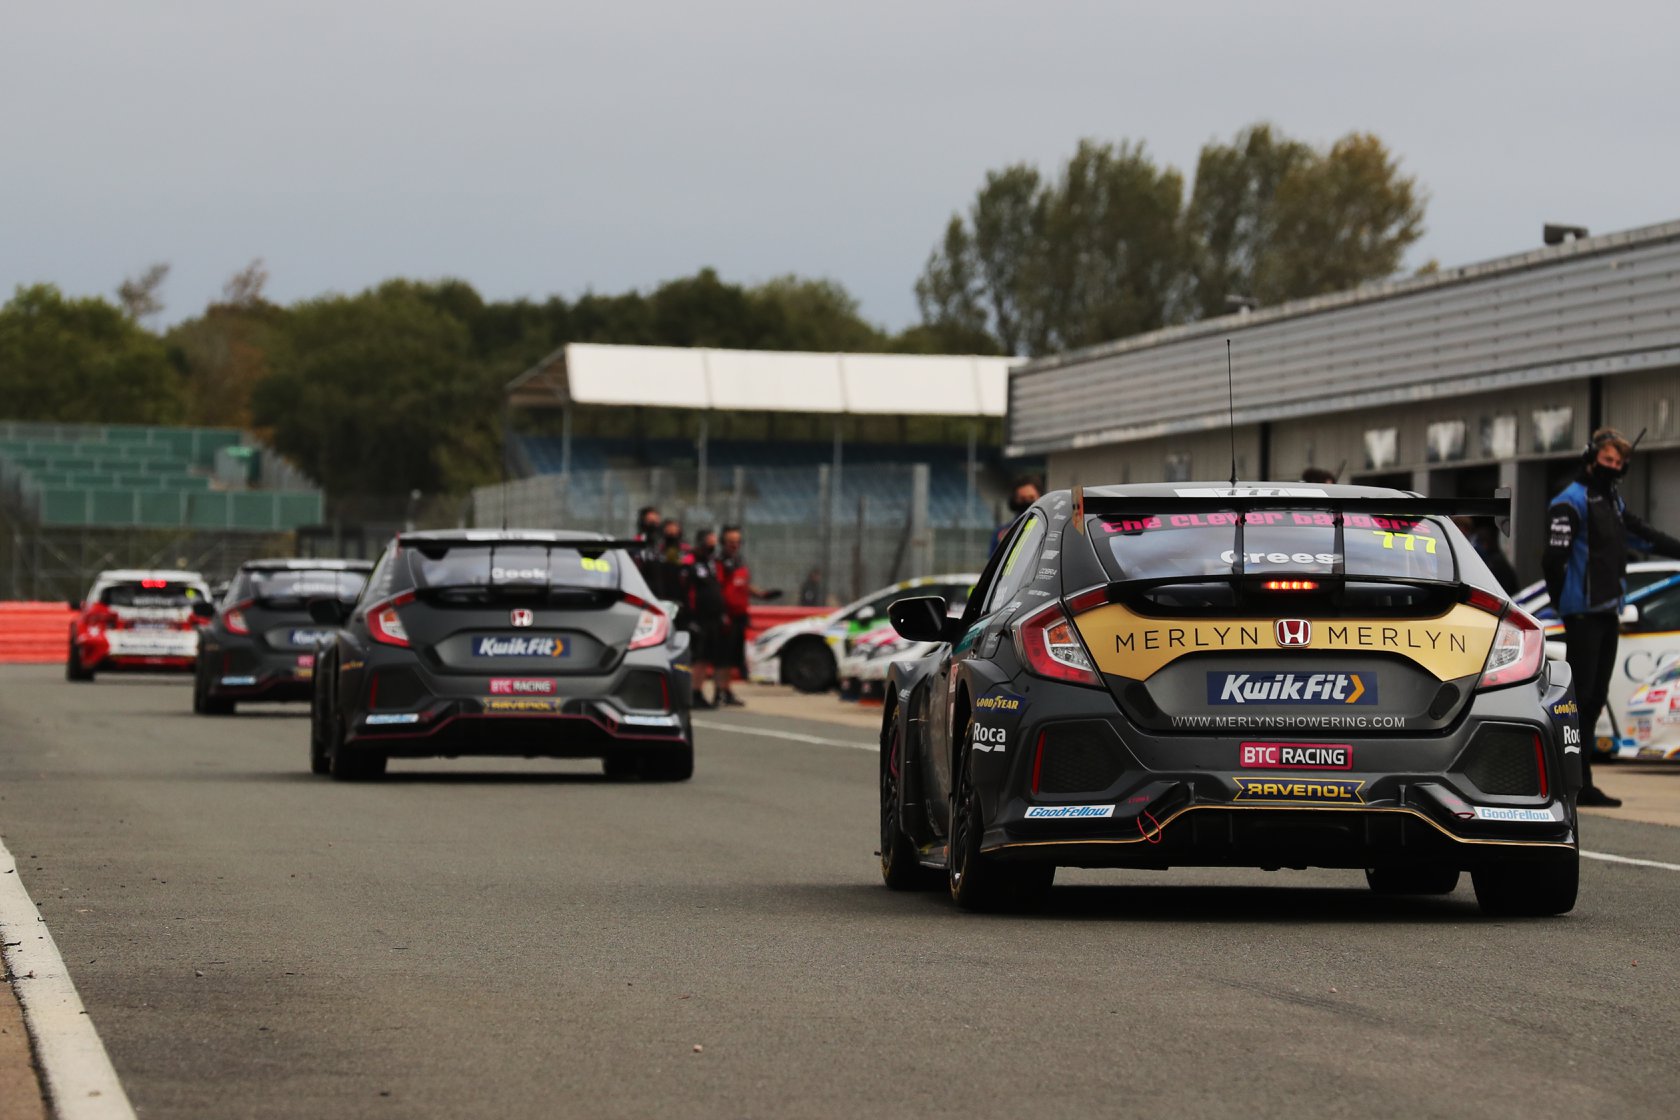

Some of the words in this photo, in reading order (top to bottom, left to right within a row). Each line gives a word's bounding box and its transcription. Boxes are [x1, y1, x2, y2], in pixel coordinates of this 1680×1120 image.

[1100, 514, 1163, 533] the
[1373, 531, 1437, 554] 777
[1220, 550, 1343, 564] Crees
[1116, 627, 1259, 653] MERLYN
[1329, 626, 1467, 653] MERLYN
[491, 680, 511, 692] BTC
[513, 680, 551, 692] RACING
[1172, 715, 1406, 729] WWW.MERLYNSHOWERING.COM
[973, 723, 1006, 742] Roca
[1563, 725, 1580, 745] Roc
[1244, 746, 1276, 763] BTC
[1282, 748, 1345, 765] RACING
[1248, 783, 1351, 798] RAVENOL
